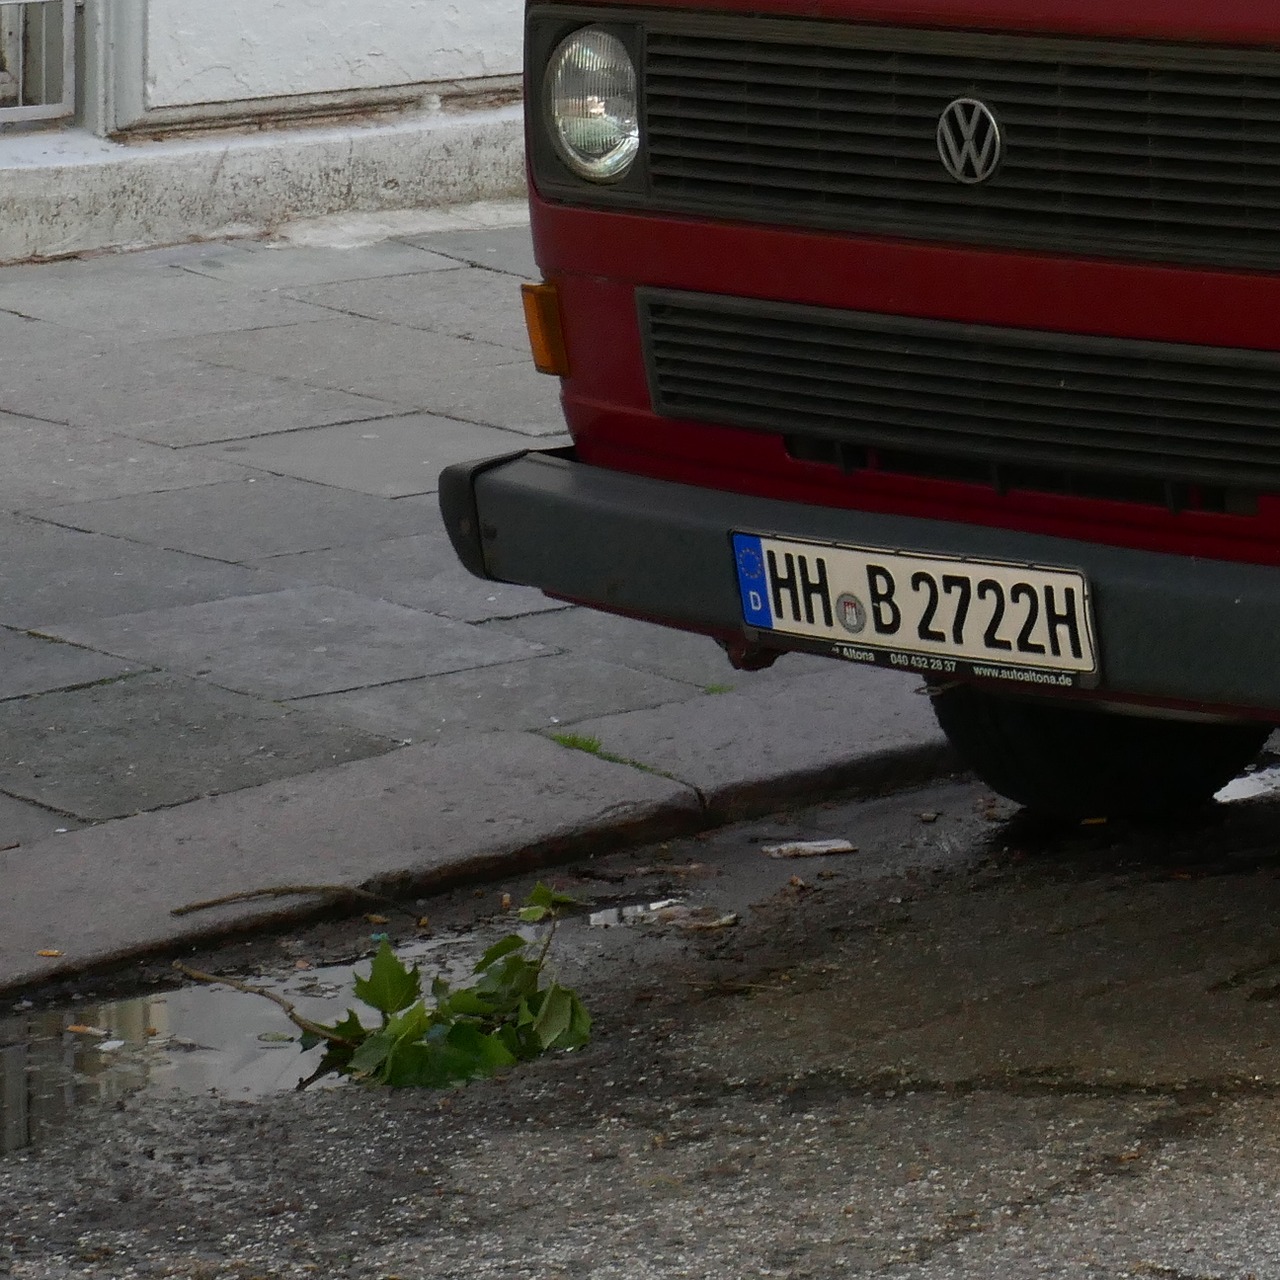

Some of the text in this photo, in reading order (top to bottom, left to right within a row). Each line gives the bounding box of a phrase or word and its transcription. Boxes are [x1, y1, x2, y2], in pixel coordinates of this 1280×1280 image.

[750, 591, 761, 611] D
[766, 549, 1083, 660] HH B 2722H
[944, 660, 956, 672] 37
[973, 664, 1073, 687] www.autoaltona.de
